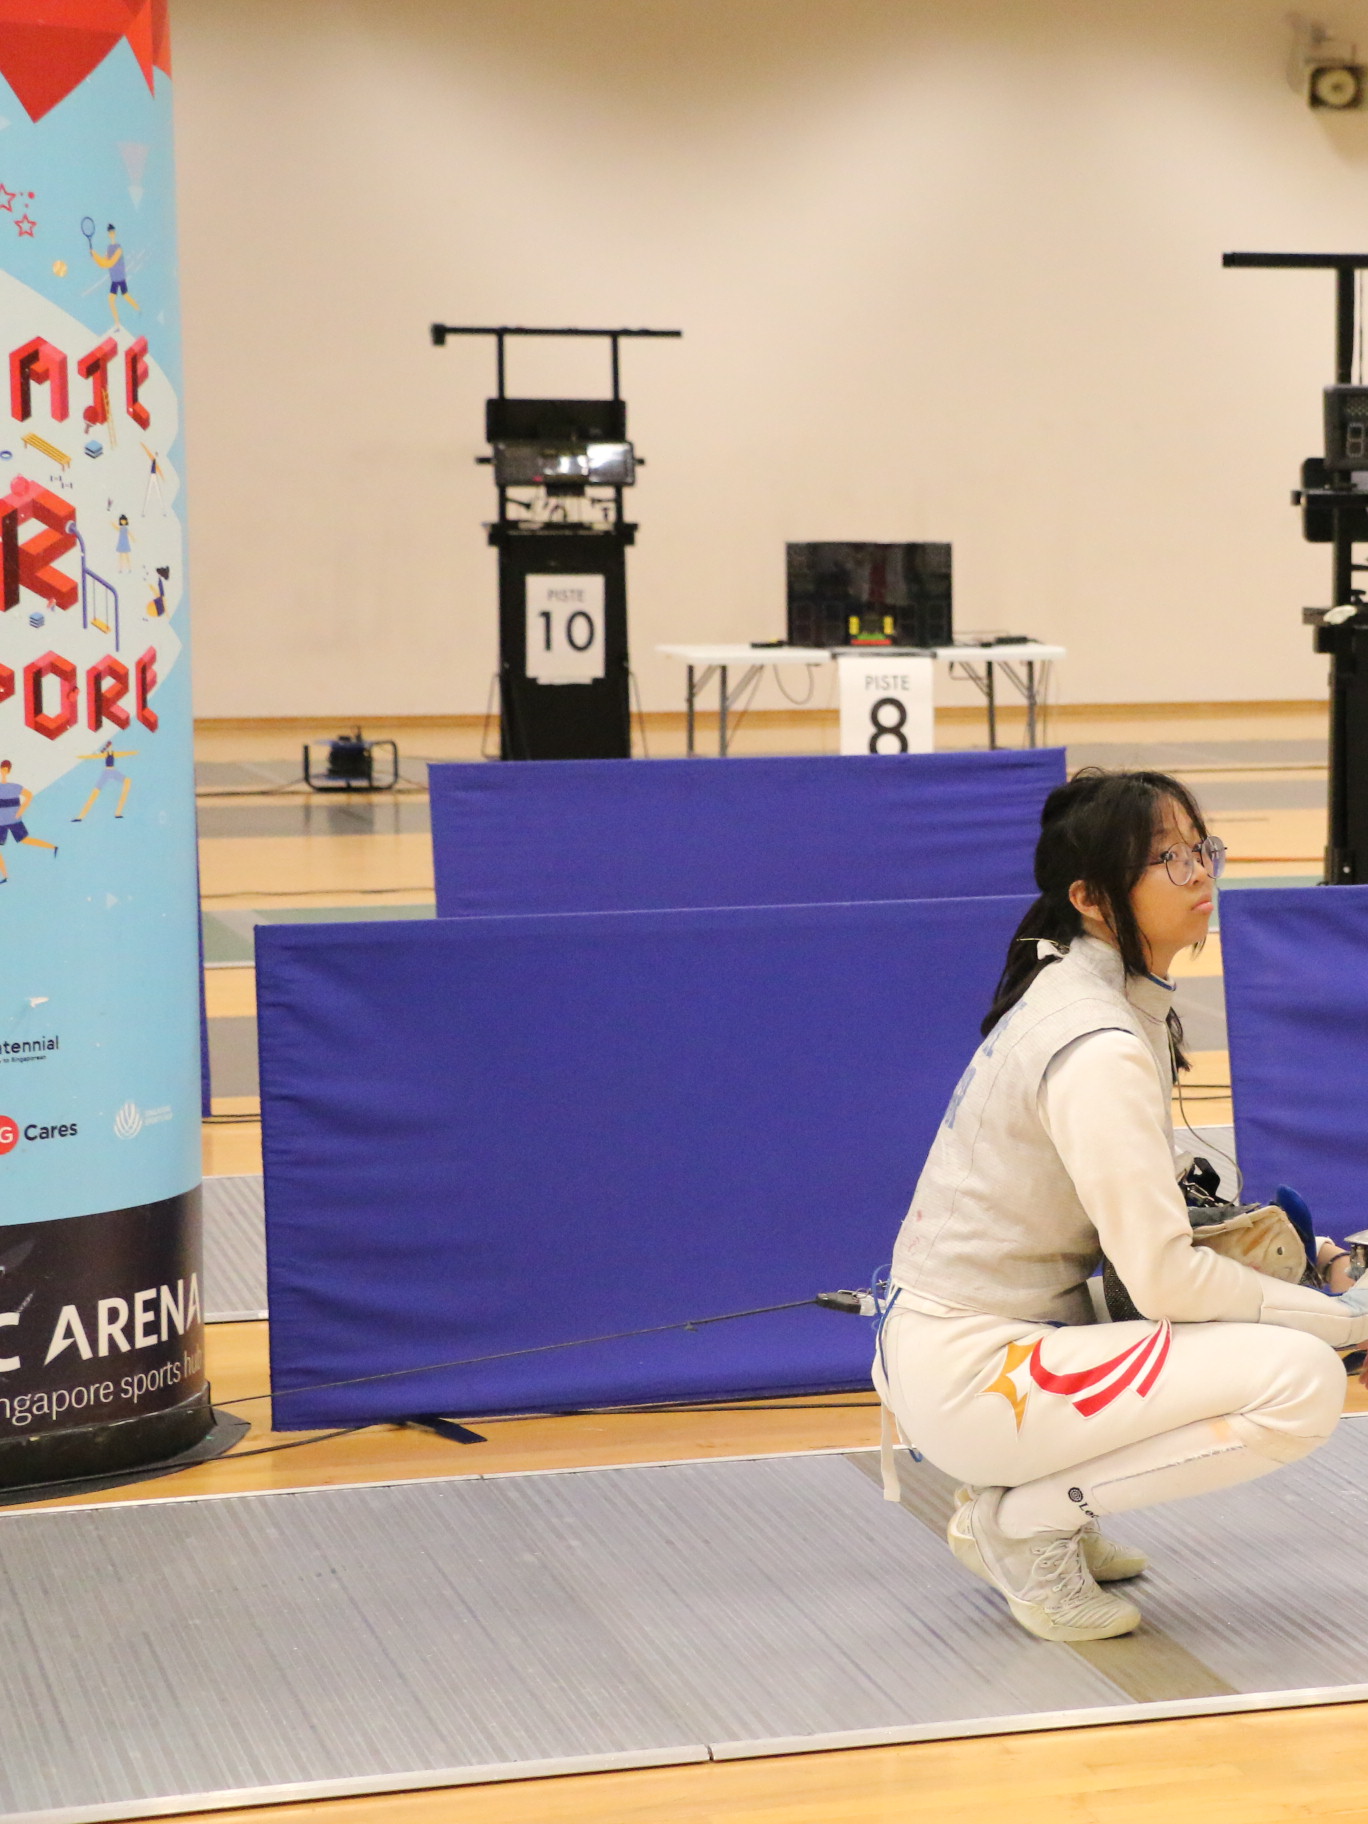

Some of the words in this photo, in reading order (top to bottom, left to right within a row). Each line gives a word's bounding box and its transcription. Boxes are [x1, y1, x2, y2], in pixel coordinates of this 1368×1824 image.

[539, 611, 595, 651] 10
[865, 675, 909, 691] PISTE
[869, 697, 908, 754] 8
[0, 1035, 59, 1054] tennial
[24, 1122, 78, 1141] Cares
[44, 1272, 201, 1368] ARENA
[121, 1361, 182, 1404] sports
